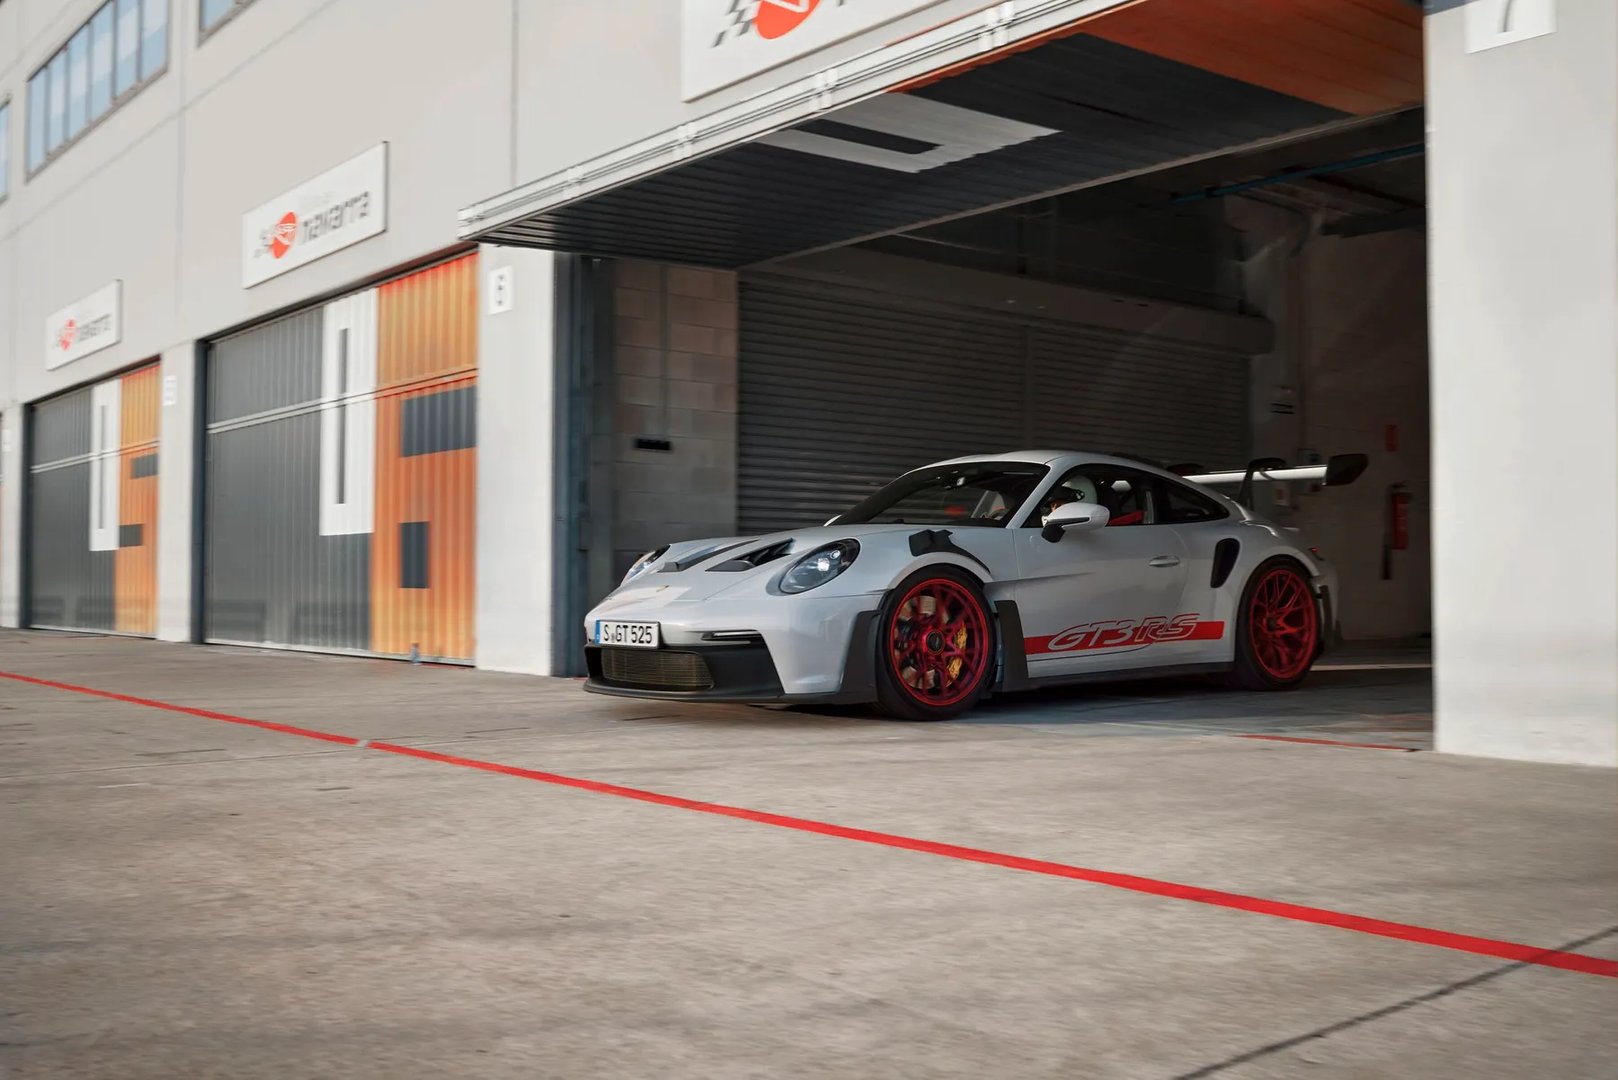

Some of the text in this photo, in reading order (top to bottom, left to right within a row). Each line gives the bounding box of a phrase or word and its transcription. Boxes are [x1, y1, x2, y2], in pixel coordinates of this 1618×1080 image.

[603, 624, 653, 644] S GT 525
